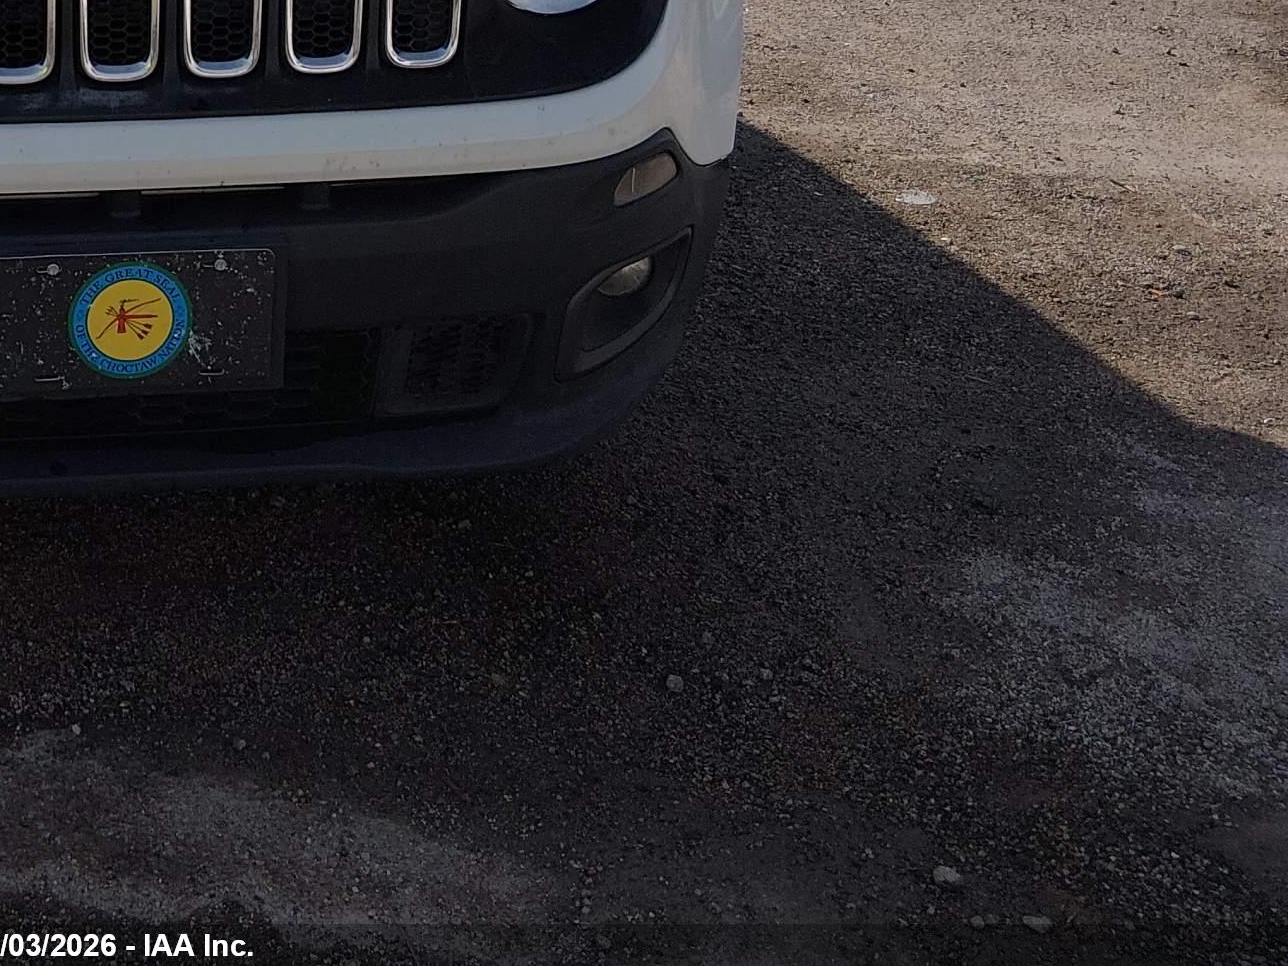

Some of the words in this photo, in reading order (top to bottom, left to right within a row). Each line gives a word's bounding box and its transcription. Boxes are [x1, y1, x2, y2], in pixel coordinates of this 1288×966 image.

[79, 280, 105, 305] THE
[104, 268, 152, 283] GREAT
[75, 324, 87, 342] OF
[100, 358, 158, 373] CHOCTAW
[158, 319, 185, 359] NATION
